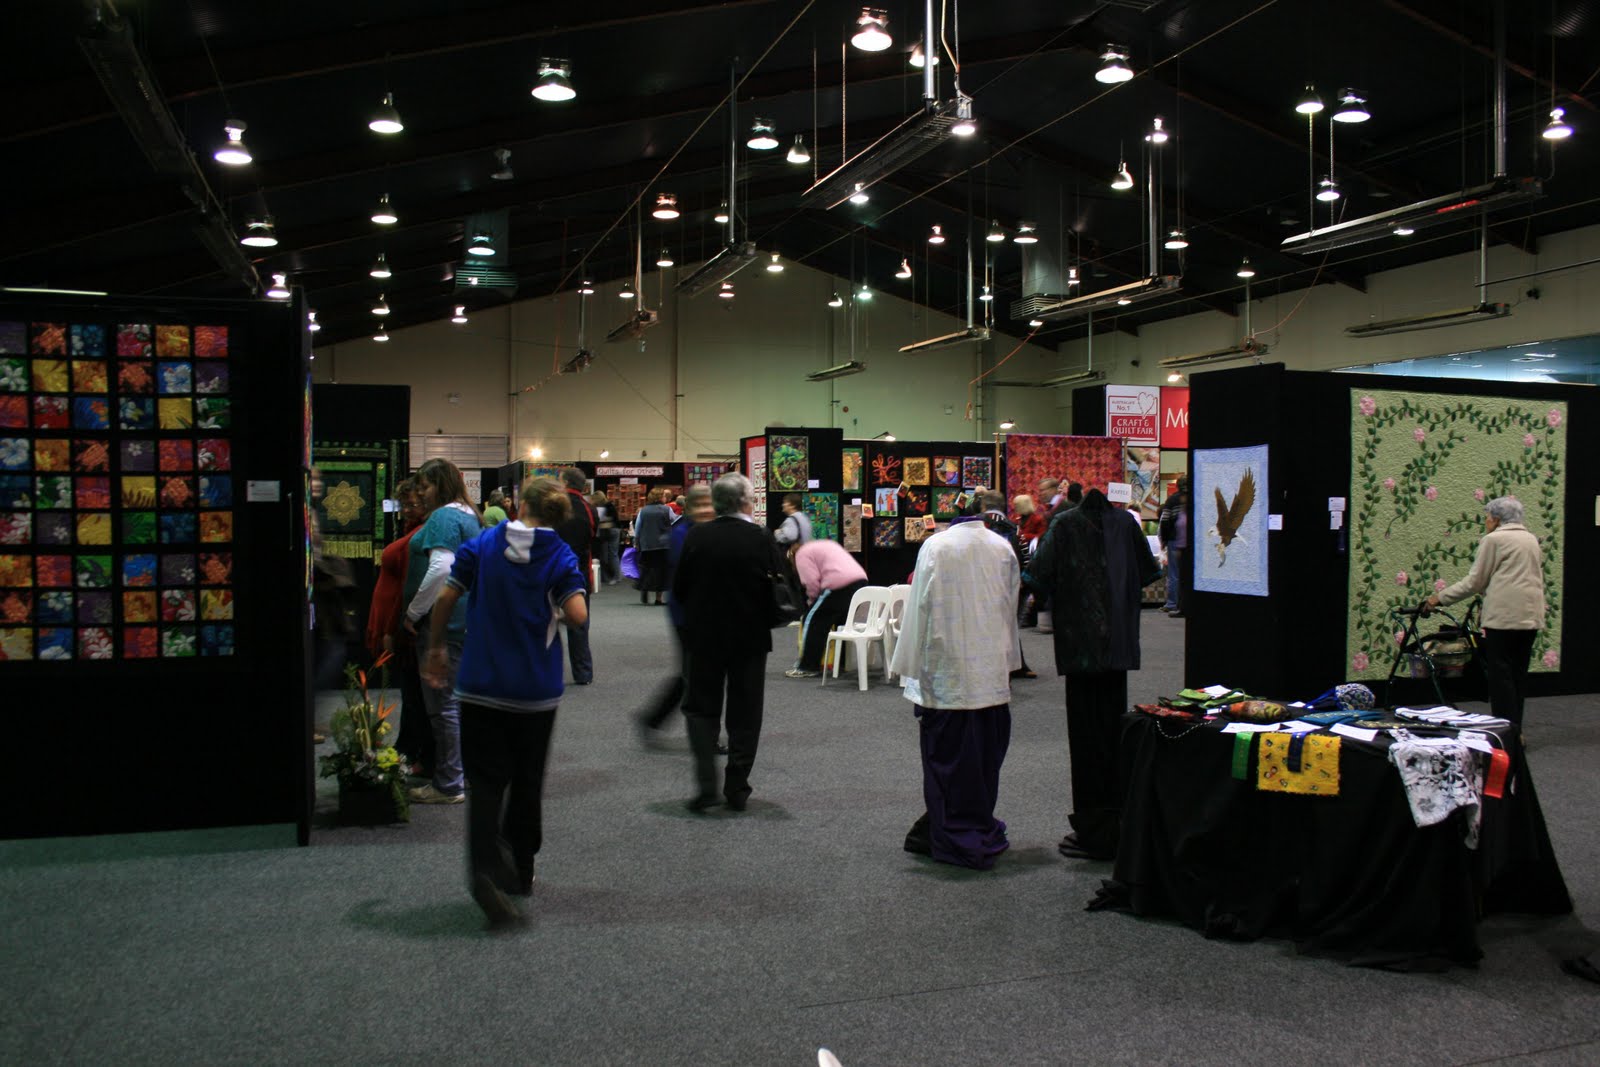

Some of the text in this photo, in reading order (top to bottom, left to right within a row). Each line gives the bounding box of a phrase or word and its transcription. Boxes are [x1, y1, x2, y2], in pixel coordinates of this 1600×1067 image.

[1116, 418, 1142, 427] CRAFT
[1112, 427, 1154, 435] QUILT FAIR
[598, 467, 619, 475] Quilts
[622, 467, 633, 475] for
